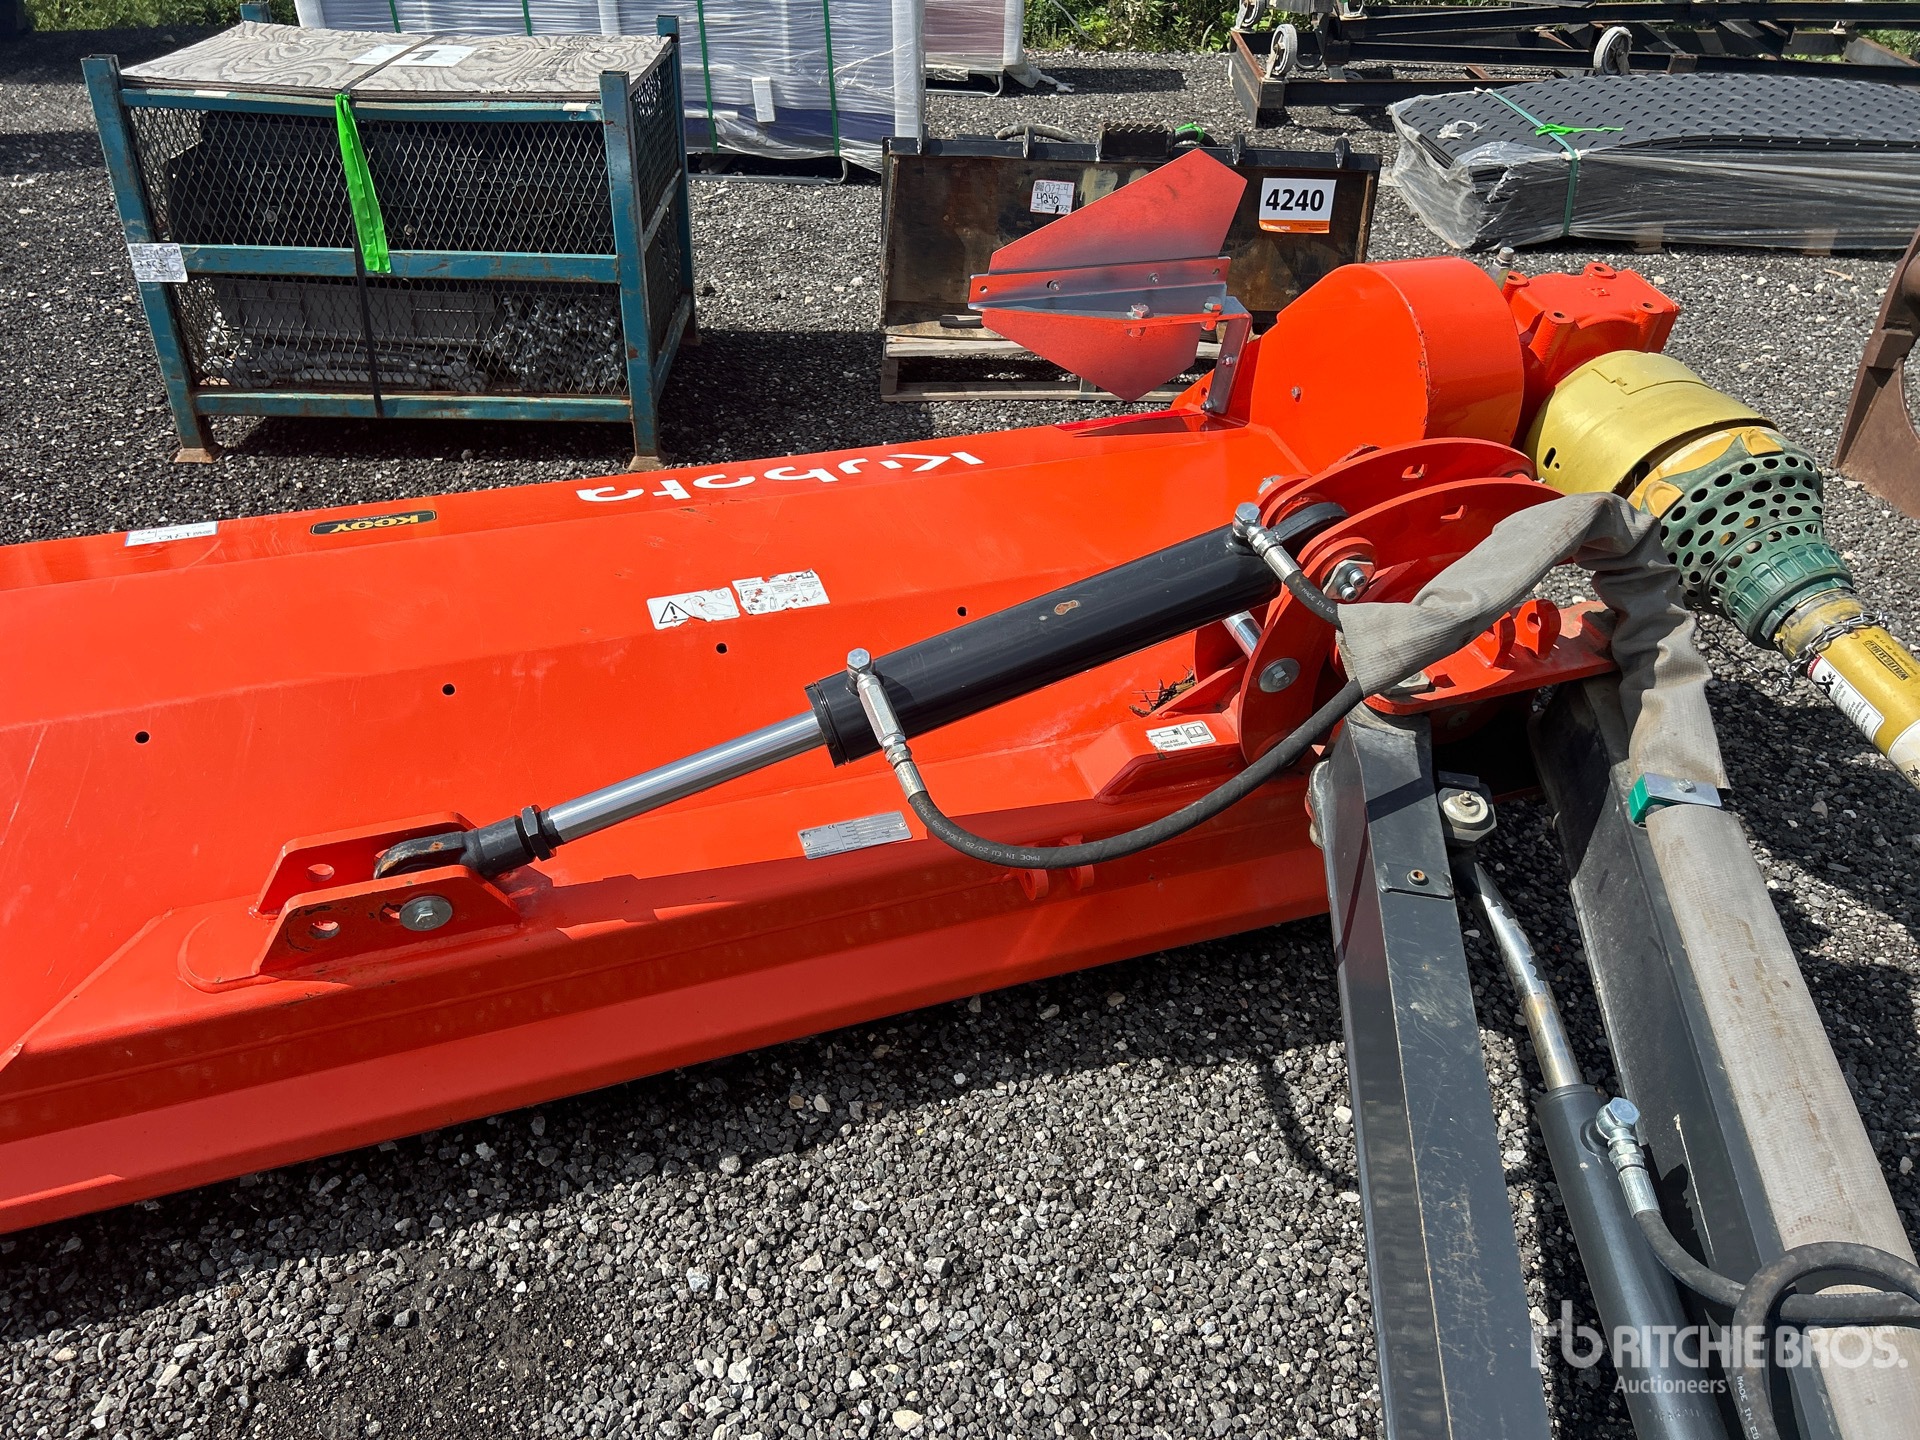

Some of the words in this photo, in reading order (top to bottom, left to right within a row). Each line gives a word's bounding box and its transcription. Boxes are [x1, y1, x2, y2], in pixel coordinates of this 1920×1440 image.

[1036, 192, 1060, 205] 4240
[1265, 188, 1325, 212] 4240
[576, 451, 985, 503] Kubota
[329, 514, 418, 533] KOOY
[1301, 588, 1316, 601] MADE
[1317, 600, 1325, 608] IN
[965, 841, 989, 854] 20/20
[991, 850, 1002, 858] EU
[1005, 852, 1015, 860] IN
[1737, 1375, 1748, 1402] MADE
[1744, 1407, 1754, 1421] IN
